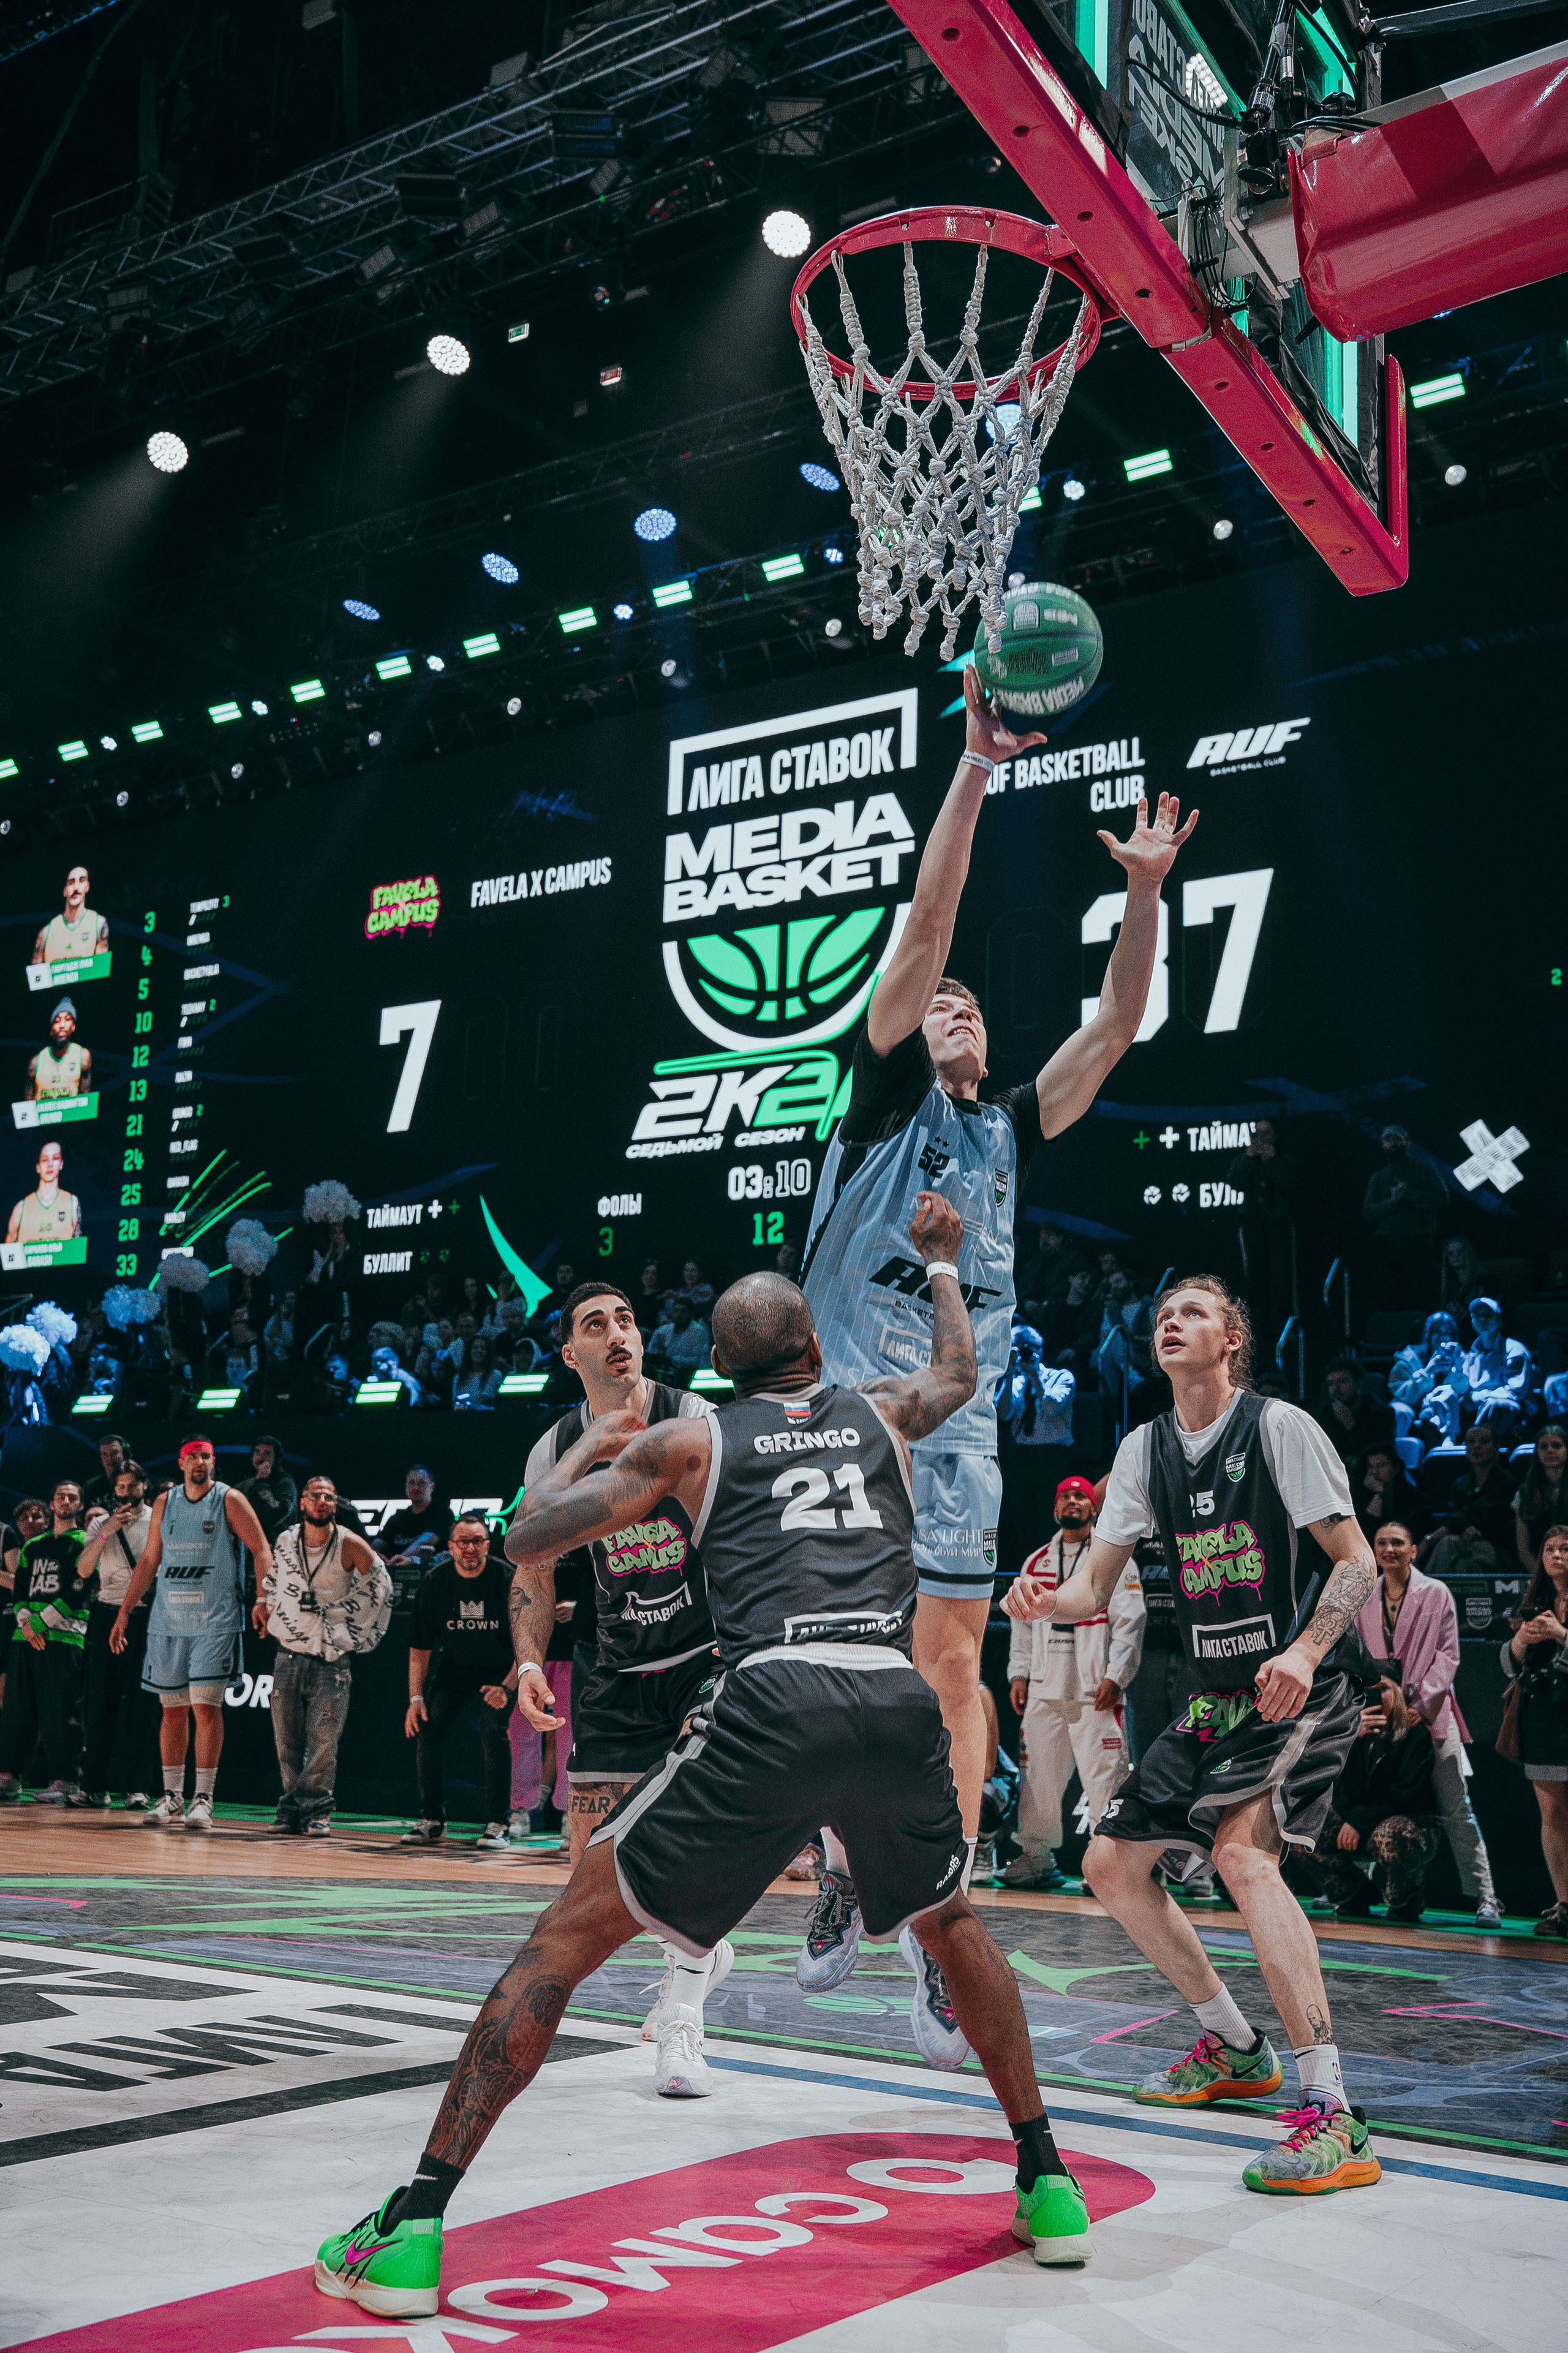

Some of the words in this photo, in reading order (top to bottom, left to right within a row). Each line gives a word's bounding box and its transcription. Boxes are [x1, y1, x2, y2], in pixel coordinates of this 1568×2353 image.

[1186, 717, 1311, 769] AUF
[688, 755, 764, 811] ЛИГА
[770, 727, 894, 794] СТАВОК
[984, 761, 1011, 796] UF
[1015, 737, 1145, 790] BASKETBALL
[1090, 775, 1145, 813] CLUB
[665, 793, 914, 882] MEDIA
[372, 876, 439, 912] FAVELA
[470, 873, 527, 907] FAVELA
[529, 870, 542, 897] X
[544, 857, 612, 894] CAMPUS
[663, 839, 914, 923] BASKET
[144, 912, 155, 932] 3
[366, 899, 441, 936] CAMPUS
[141, 946, 152, 967] 4
[138, 978, 149, 1000] 5
[1551, 969, 1562, 985] 2
[135, 1011, 153, 1033] 10
[131, 1045, 149, 1067] 12
[379, 999, 442, 1133] 7
[129, 1080, 146, 1101] 13
[126, 1114, 143, 1136] 21
[625, 1133, 723, 1158] СЕДЬМОЙ
[734, 1127, 805, 1147] СЕЗОН
[124, 1149, 144, 1171] 24
[918, 1143, 951, 1179] 52
[728, 1158, 811, 1200] 03:10
[121, 1184, 141, 1206] 25
[597, 1193, 642, 1217] ФОЛЫ
[367, 1203, 423, 1228] ТАЙМАУТ
[753, 1211, 784, 1245] 12
[118, 1218, 138, 1241] 28
[598, 1226, 612, 1256] 3
[116, 1255, 137, 1275] 33
[363, 1250, 413, 1274] БУЛЛИТ
[753, 1427, 861, 1455] GRINGO
[771, 1463, 883, 1532] 21
[32, 1558, 48, 1576] IN
[165, 1566, 215, 1579] AUF
[29, 1574, 60, 1598] LAB
[638, 1595, 685, 1626] СТАВОК
[447, 1620, 500, 1631] CROWN
[1223, 1630, 1269, 1657] СТАВОК
